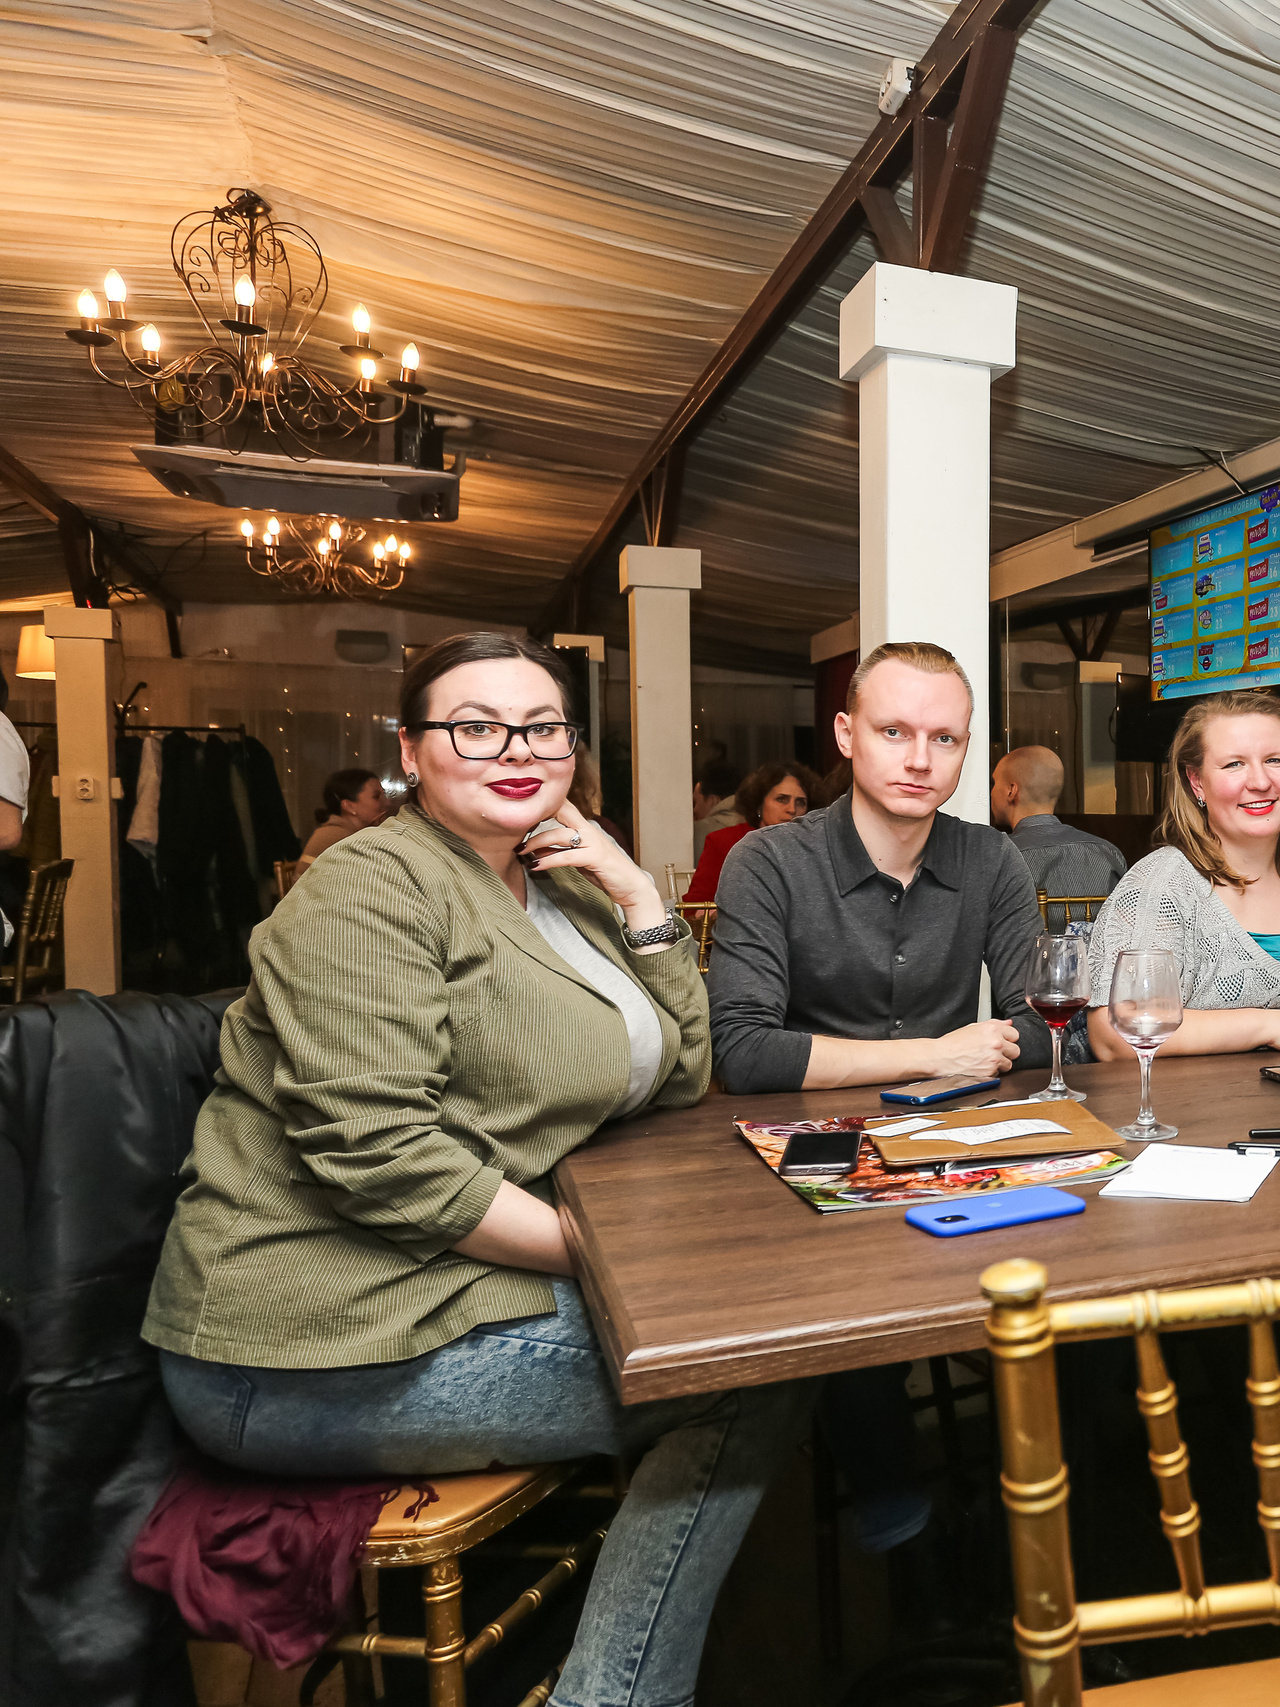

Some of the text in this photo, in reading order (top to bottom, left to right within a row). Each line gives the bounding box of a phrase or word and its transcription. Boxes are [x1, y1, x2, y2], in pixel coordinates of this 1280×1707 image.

[1272, 526, 1277, 538] 9
[1269, 566, 1278, 579] 16
[1270, 646, 1280, 658] 30
